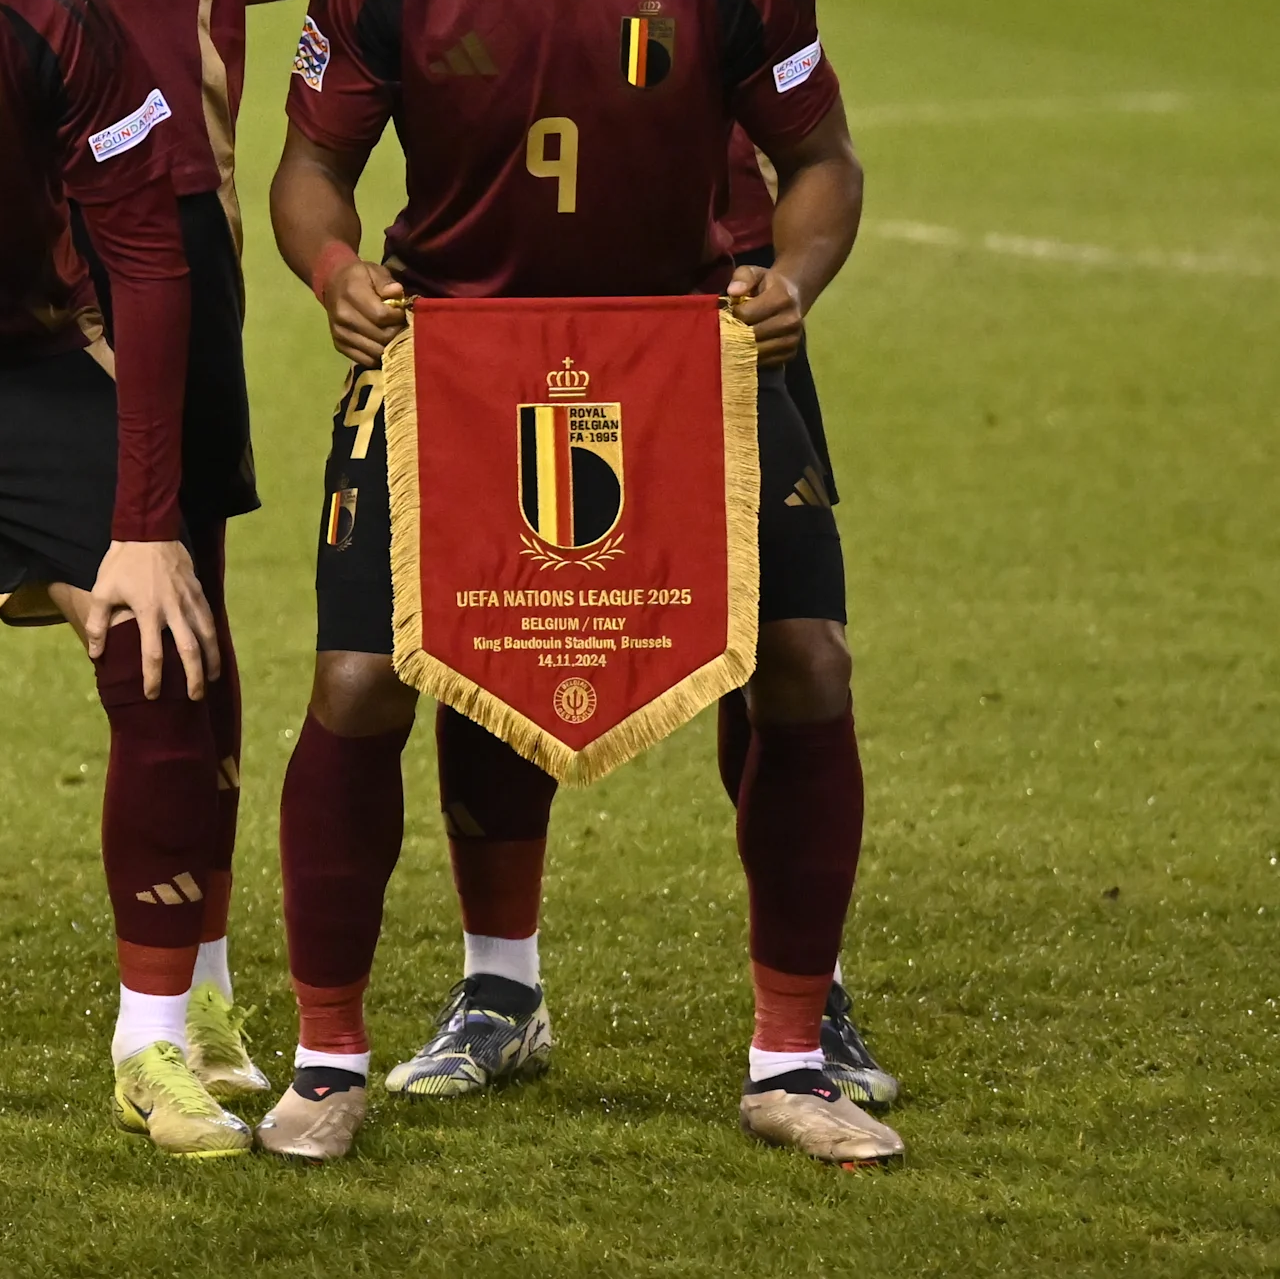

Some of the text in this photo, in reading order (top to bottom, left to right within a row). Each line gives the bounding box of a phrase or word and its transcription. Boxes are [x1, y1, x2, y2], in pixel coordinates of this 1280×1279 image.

[777, 60, 793, 73] UEFA
[95, 99, 164, 153] FOUNDATION
[92, 131, 111, 144] UEFA
[526, 117, 579, 213] 9
[343, 369, 384, 459] 9
[570, 408, 607, 418] ROYAL
[571, 420, 619, 430] BELGIAN
[456, 589, 692, 607] UEFA NATIONS LEAGUE 2025
[521, 617, 579, 630] BELGIUM
[593, 617, 627, 630] ITALY
[473, 636, 673, 652] King Baudouin Stadium, Brussels
[538, 654, 607, 667] 14.11.2024
